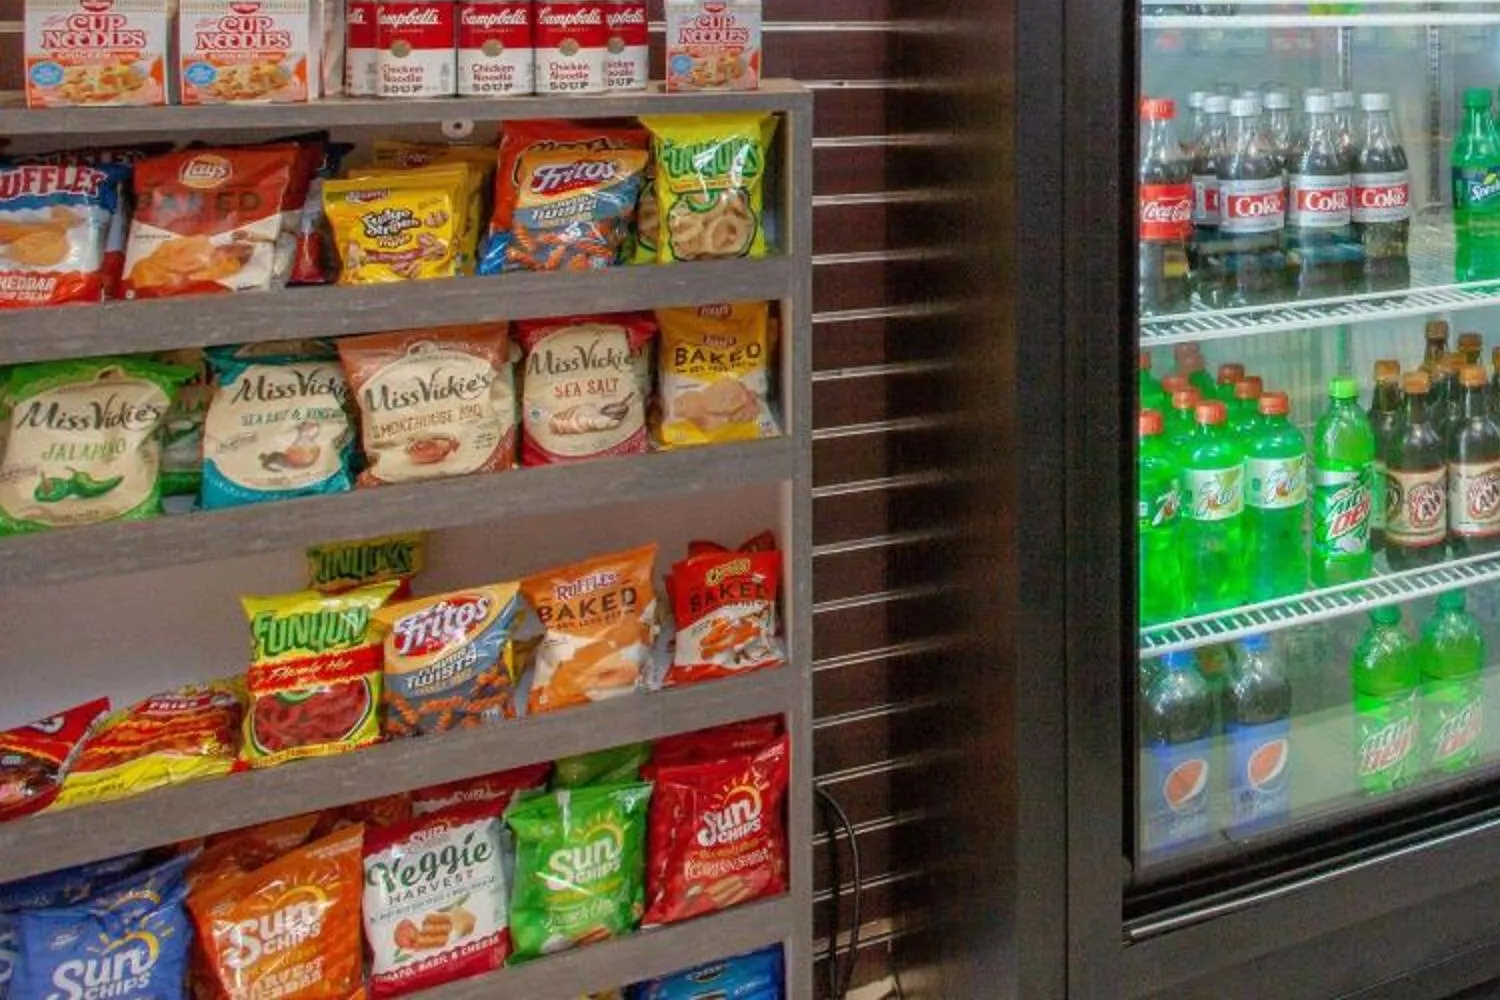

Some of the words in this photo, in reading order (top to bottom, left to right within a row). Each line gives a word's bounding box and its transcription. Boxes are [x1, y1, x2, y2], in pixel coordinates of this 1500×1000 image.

[68, 14, 128, 33] CUP
[218, 16, 274, 34] CUP
[678, 27, 750, 44] NOODLES
[41, 29, 147, 51] NOODLES
[195, 31, 293, 51] NOODLES
[471, 82, 513, 92] SOUP
[550, 80, 589, 90] SOUP
[531, 160, 618, 192] Fritos
[1235, 195, 1281, 217] Coke
[1305, 191, 1348, 212] Coke
[1361, 187, 1406, 208] Coke
[527, 349, 581, 375] Miss
[675, 342, 762, 367] BAKED
[231, 375, 297, 406] Miss
[363, 383, 420, 413] Miss
[554, 382, 582, 399] SEA
[587, 378, 619, 395] SALT
[16, 399, 90, 431] Miss
[537, 587, 637, 624] BAKED
[394, 597, 489, 655] Fritos
[698, 800, 761, 847] Sun
[367, 831, 493, 893] Veggie
[549, 837, 624, 891] Sun
[389, 869, 475, 906] HARVEST
[226, 900, 325, 969] Sun
[418, 955, 449, 972] BASIL
[461, 933, 500, 957] CHEESE
[53, 948, 157, 1000] Sun
